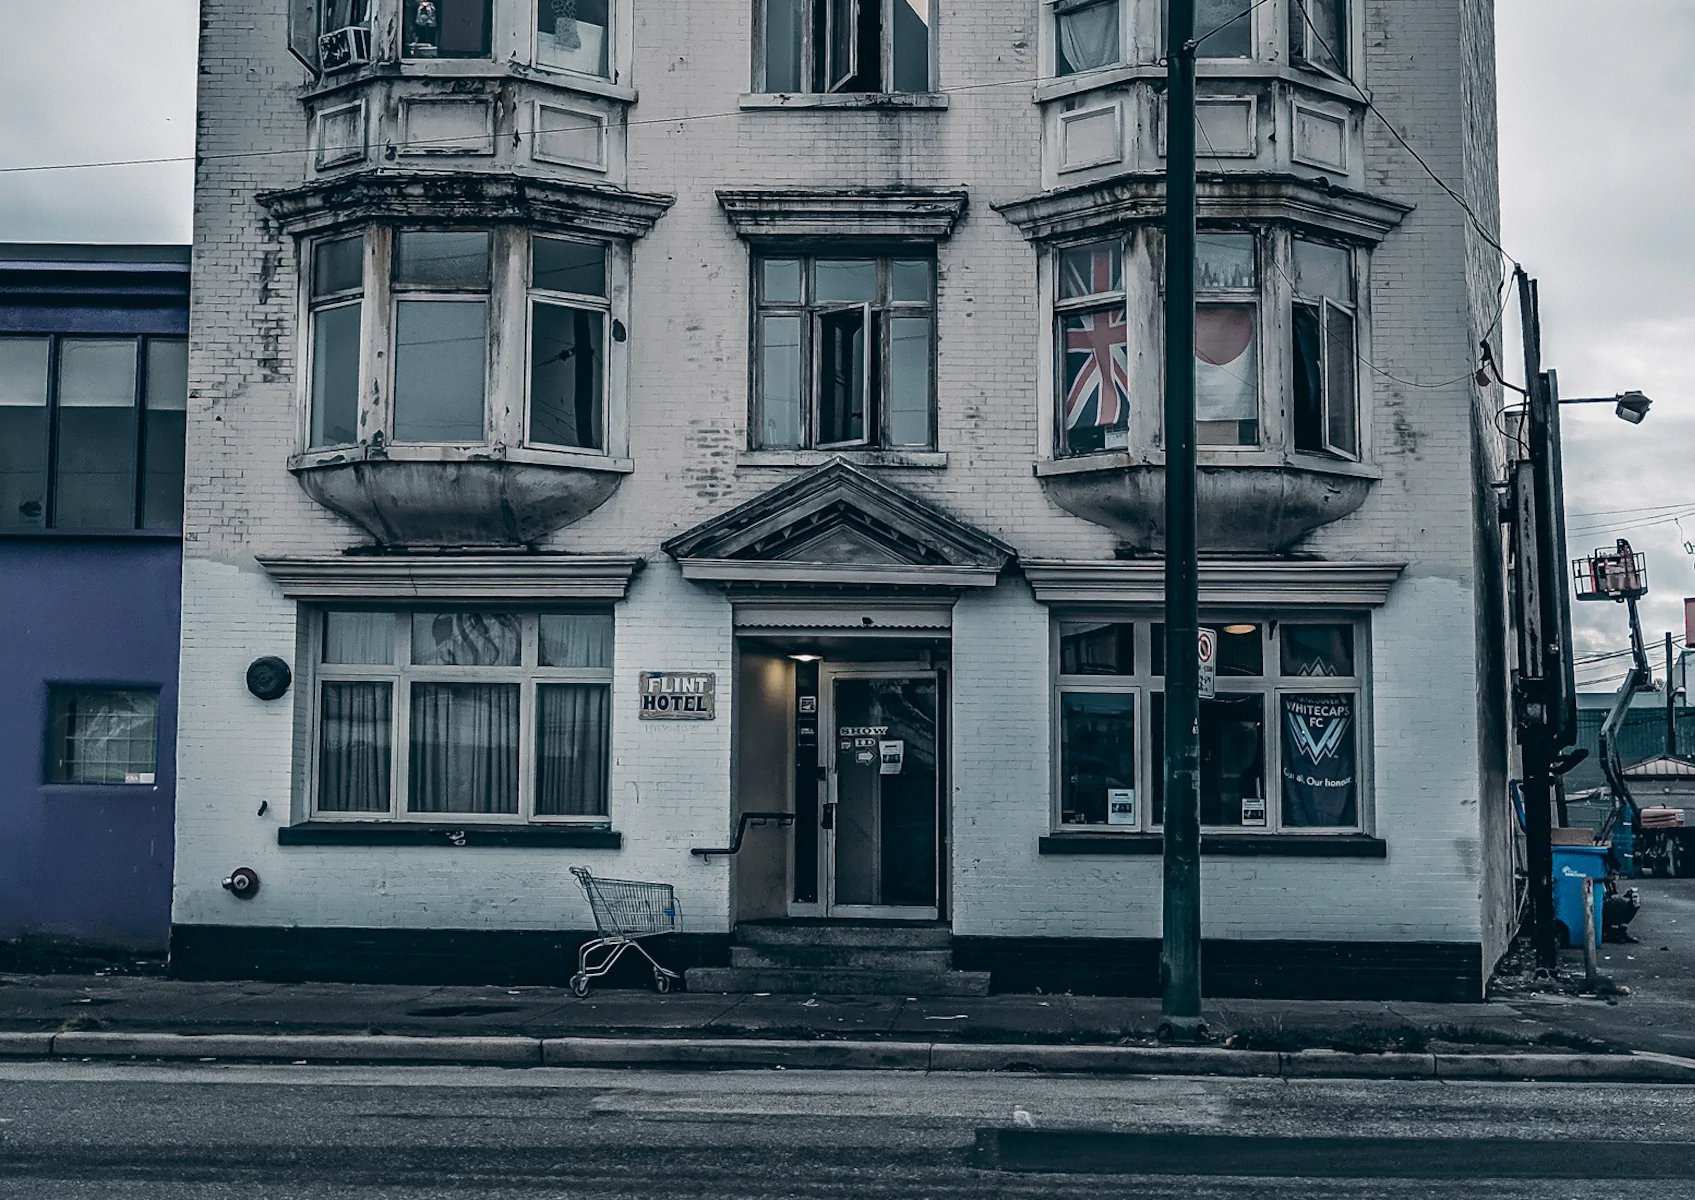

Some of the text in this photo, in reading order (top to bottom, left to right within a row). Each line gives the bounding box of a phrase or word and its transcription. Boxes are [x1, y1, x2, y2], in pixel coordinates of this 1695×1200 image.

[647, 677, 708, 692] FLINT
[643, 695, 707, 711] HOTEL
[1285, 700, 1350, 716] WHITECAPS
[1309, 717, 1324, 728] FC
[840, 726, 888, 736] SHOW
[856, 738, 876, 747] ID
[1306, 776, 1323, 786] Our
